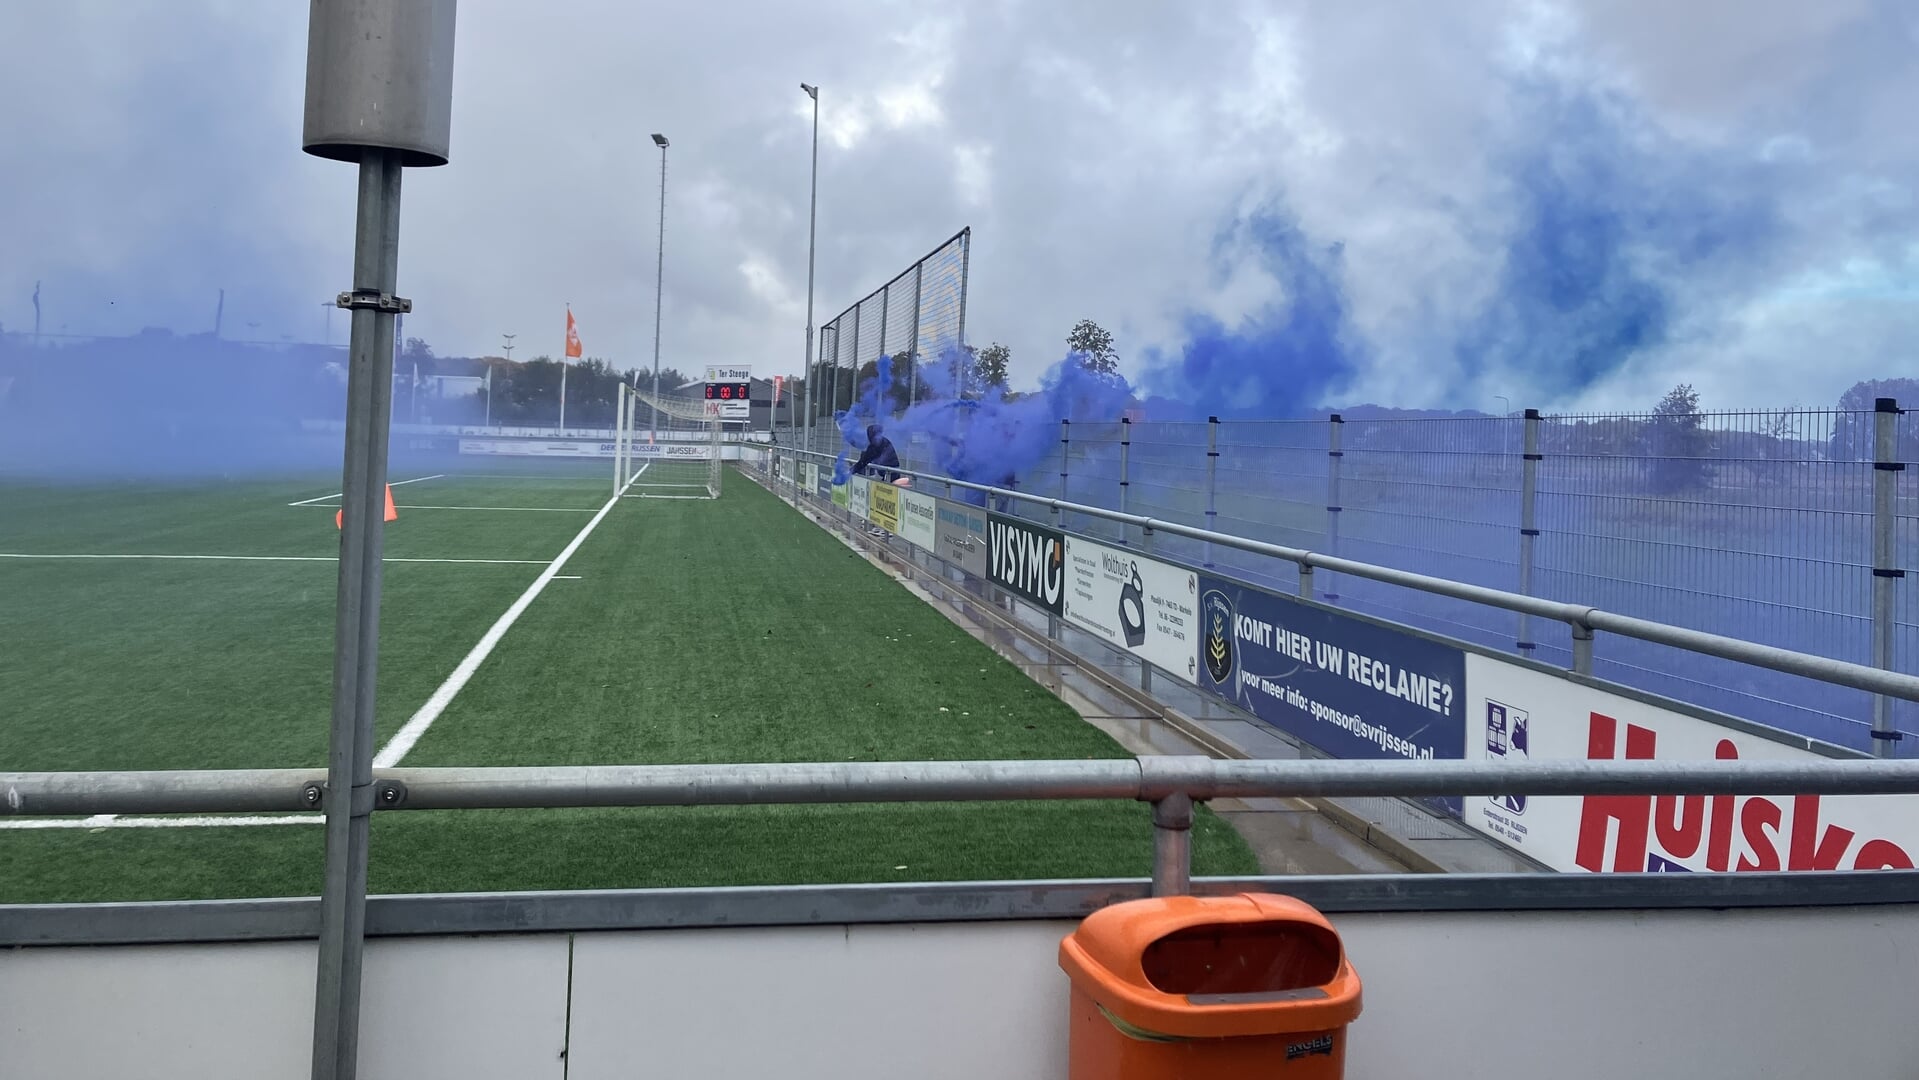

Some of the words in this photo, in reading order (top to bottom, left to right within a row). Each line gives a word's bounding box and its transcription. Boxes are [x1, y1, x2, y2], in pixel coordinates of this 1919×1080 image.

[719, 369, 728, 378] Ter
[729, 369, 749, 380] Steege
[989, 520, 1061, 605] VISYMO
[1101, 551, 1129, 578] Wolthuis
[1234, 613, 1272, 648] KOMT
[1276, 627, 1312, 664] HIER
[1316, 641, 1343, 676] UW
[1348, 651, 1453, 717] RECLAME?
[1240, 670, 1260, 689] voor
[1261, 678, 1284, 698] meer
[1286, 685, 1308, 711] info:
[1310, 700, 1434, 760] sponsor@svrijssen.nl
